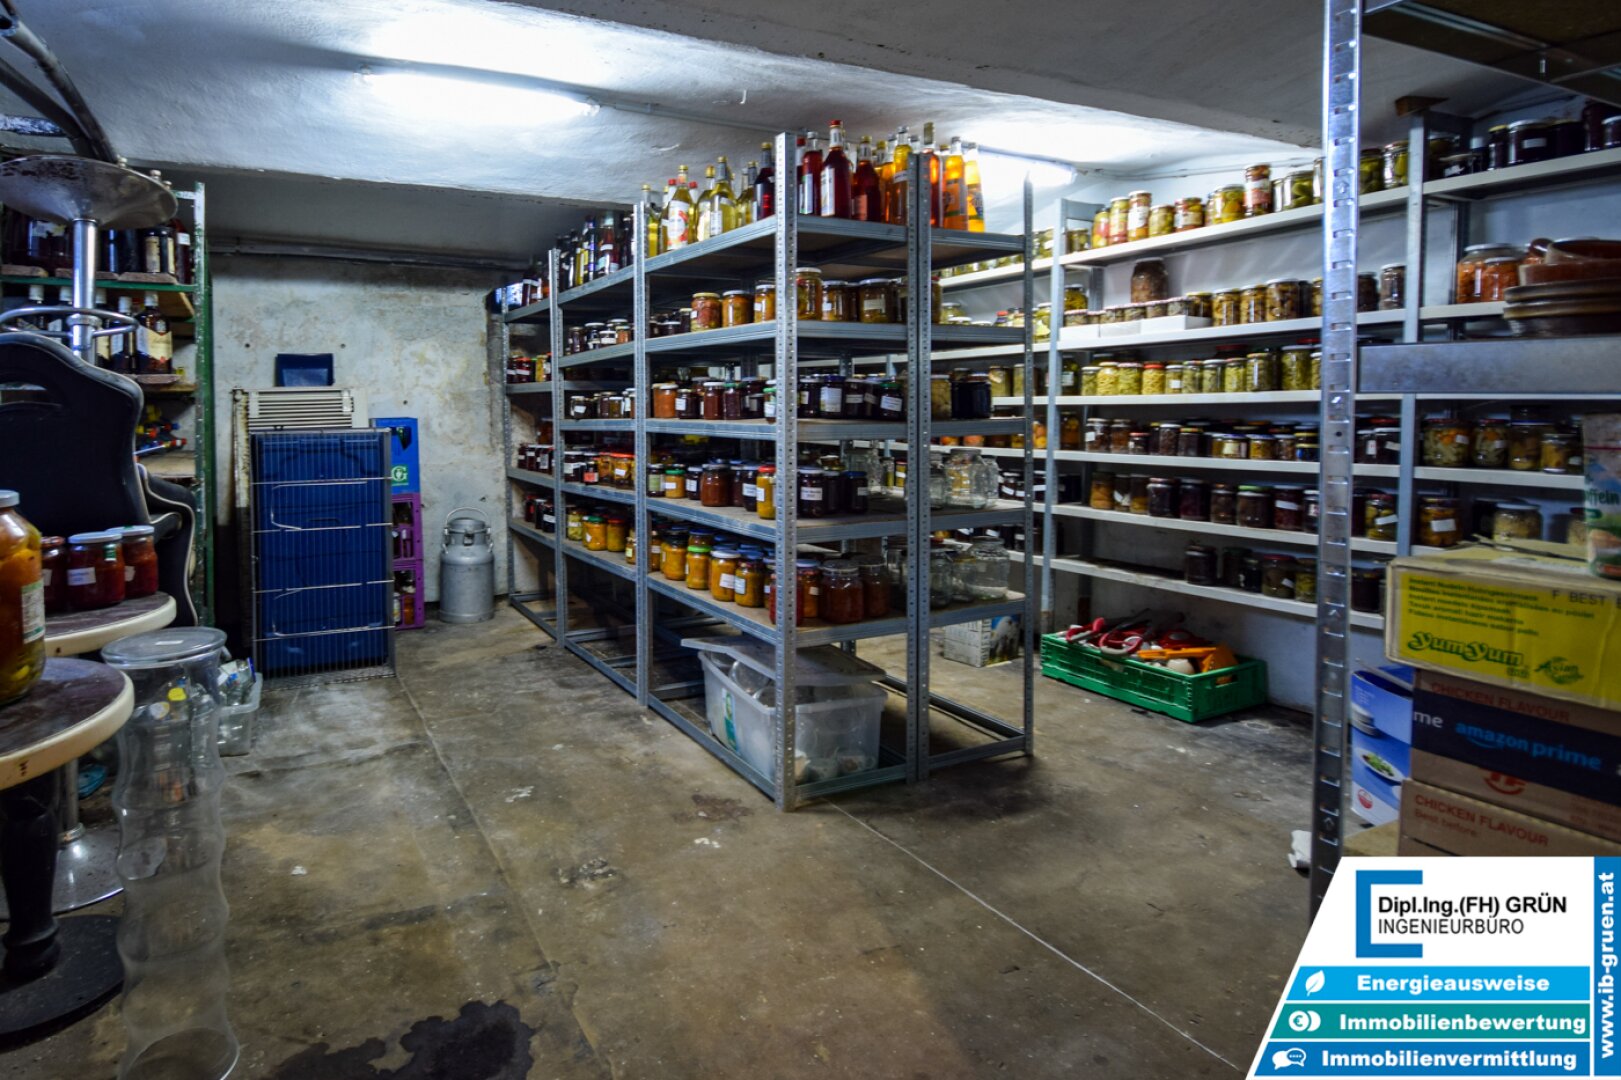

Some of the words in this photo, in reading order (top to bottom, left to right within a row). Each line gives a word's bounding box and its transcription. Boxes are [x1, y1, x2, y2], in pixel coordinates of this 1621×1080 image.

[1568, 591, 1608, 607] BEST
[1431, 681, 1495, 707] CHICKEN
[1499, 696, 1571, 723] FLAVOUR
[1455, 721, 1528, 752] amazon
[1531, 742, 1602, 772] prime
[1414, 793, 1477, 823] CHICKEN
[1479, 815, 1549, 847] FLAVOUR
